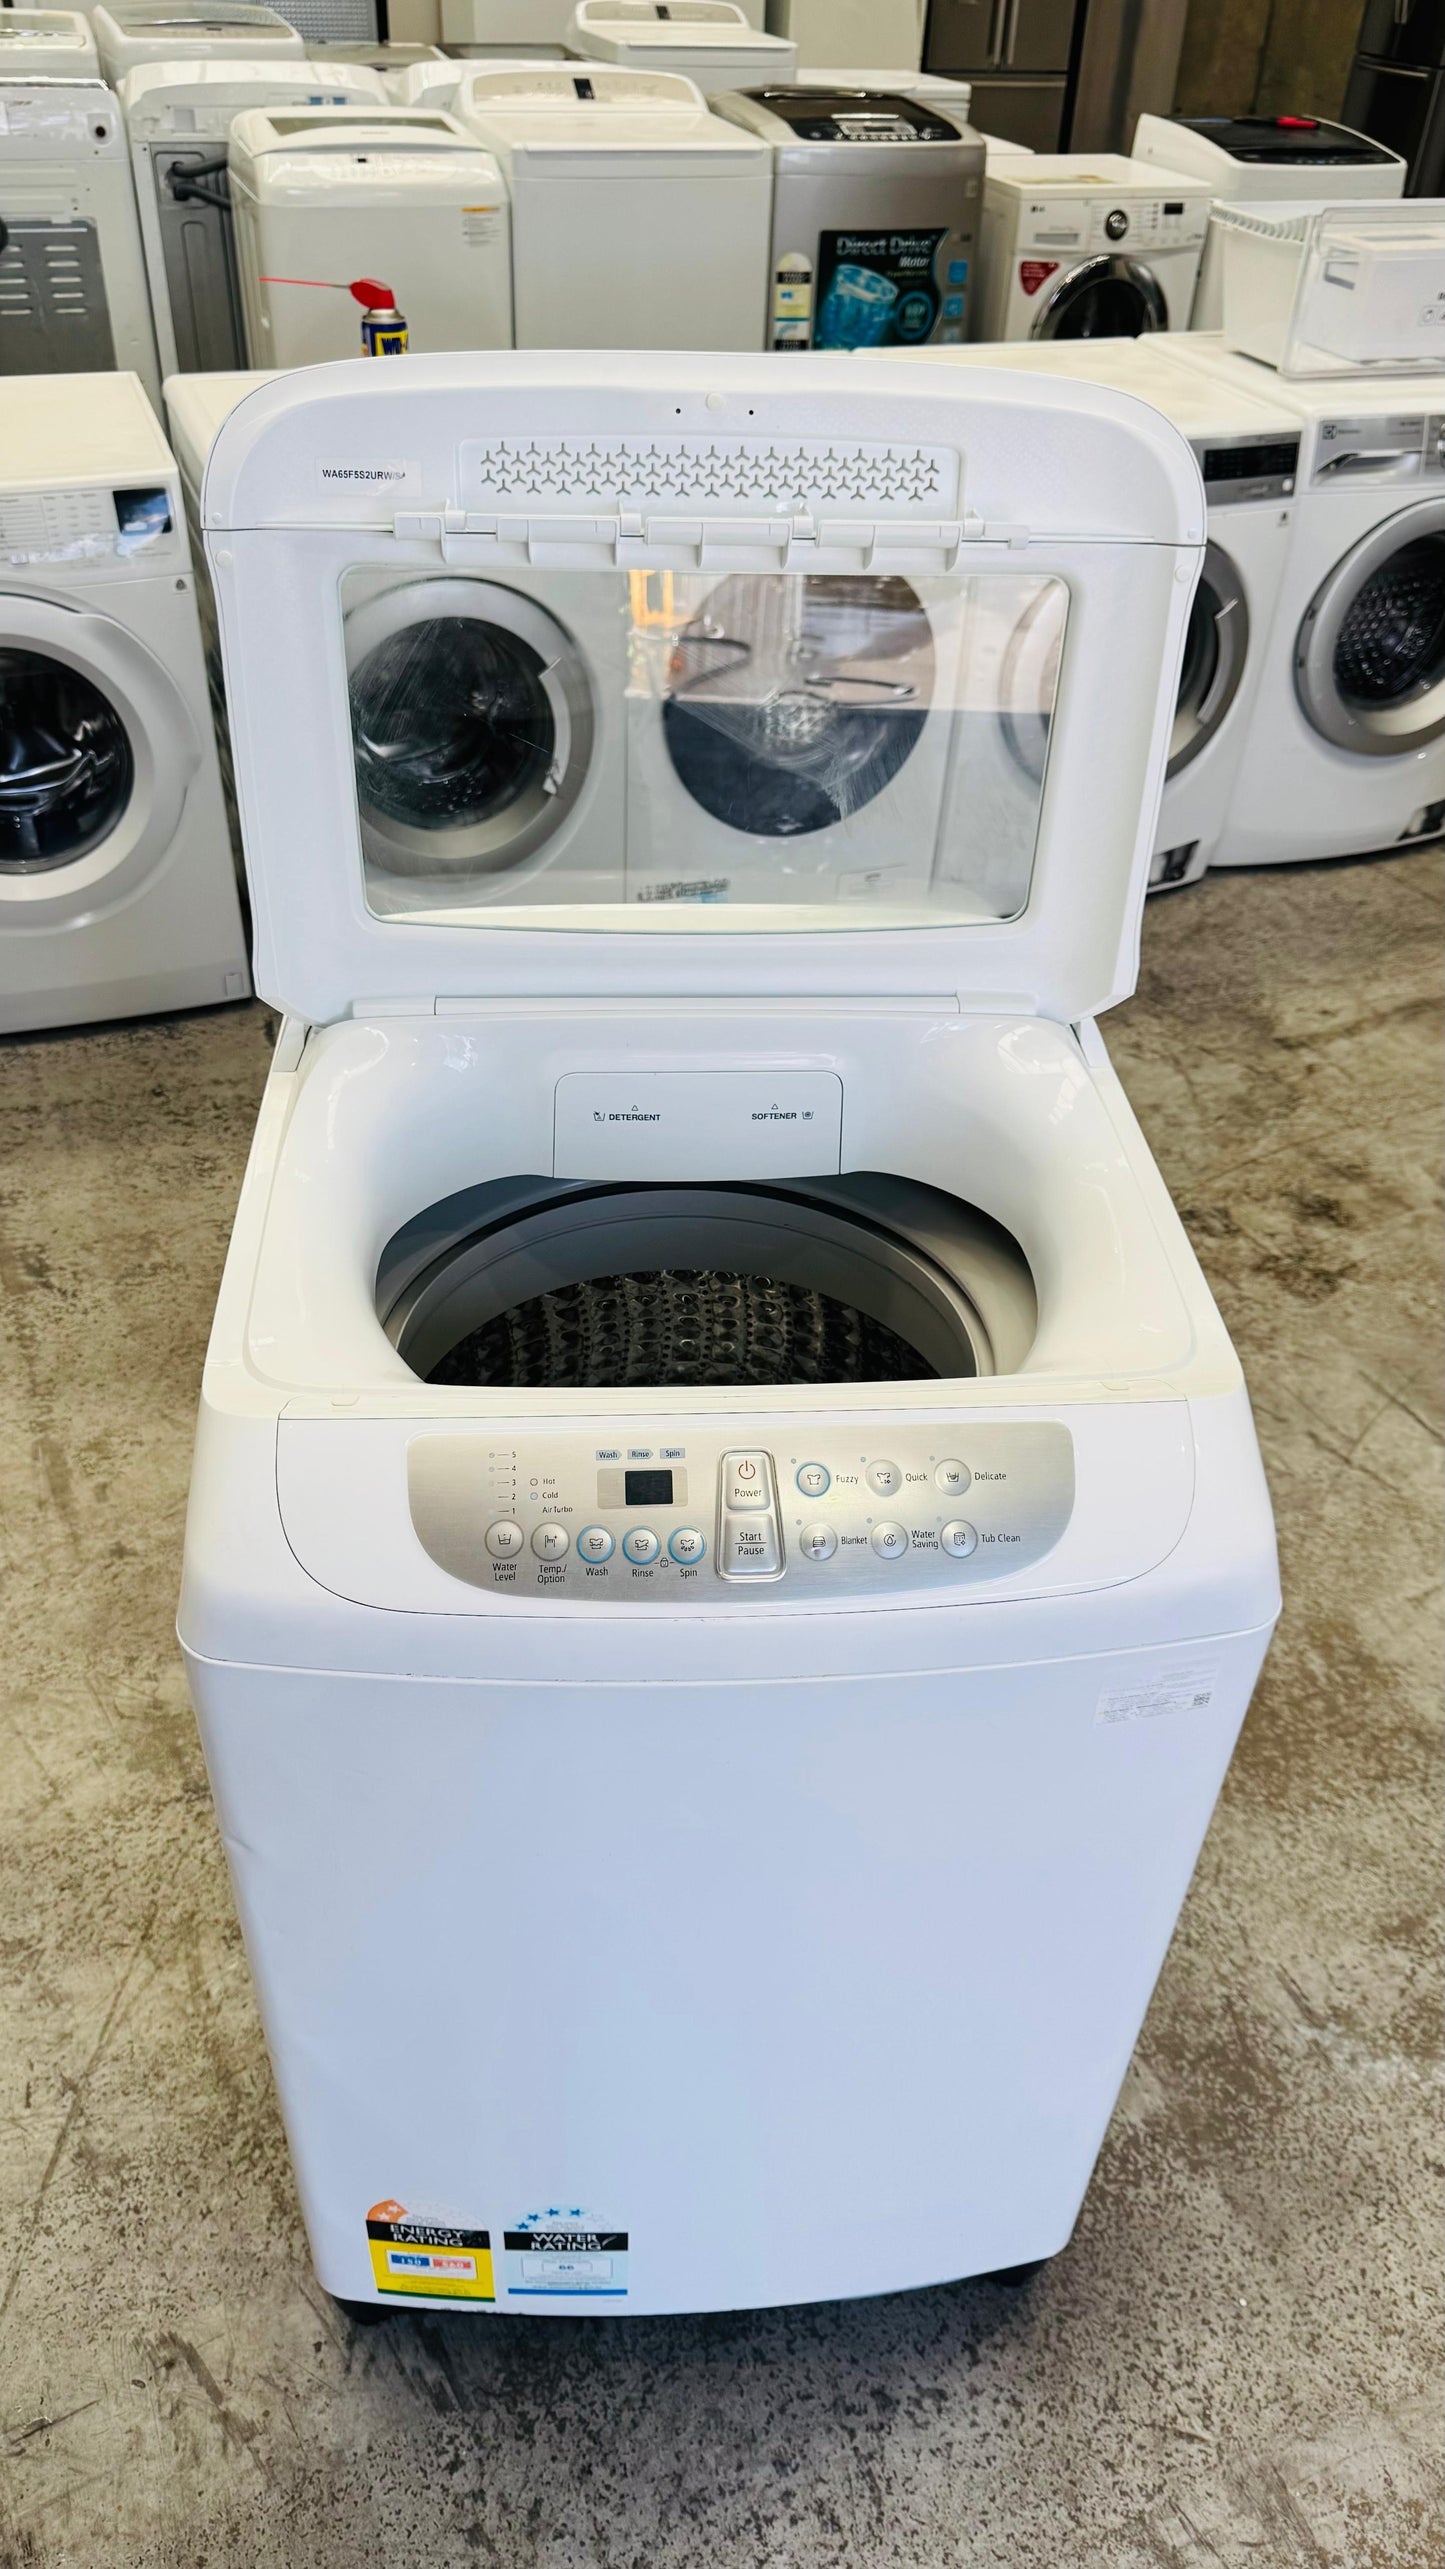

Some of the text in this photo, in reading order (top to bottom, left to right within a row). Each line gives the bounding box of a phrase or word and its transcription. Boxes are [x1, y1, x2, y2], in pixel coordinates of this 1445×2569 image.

[837, 236, 887, 255] Direct
[608, 1113, 661, 1121] DETERGENT
[751, 1111, 797, 1120] SOFTENER
[598, 1451, 618, 1459] Wash
[631, 1450, 650, 1458] Rinse
[665, 1449, 681, 1459] Spin
[835, 1474, 859, 1485] Fuzzy
[905, 1472, 928, 1481] Quick
[974, 1471, 1007, 1481] Delicate
[511, 1478, 517, 1486] 3
[542, 1491, 559, 1499] Cold
[734, 1488, 762, 1497] Power
[554, 1505, 573, 1513] Turbo
[740, 1531, 762, 1541] Start
[911, 1529, 936, 1539] Water
[981, 1533, 1021, 1543] Tub Clean
[841, 1535, 868, 1545] Blanket
[912, 1539, 939, 1549] Saving
[738, 1545, 765, 1555] Pause
[492, 1562, 518, 1572] Water
[538, 1564, 568, 1575] Temp./
[585, 1567, 609, 1577] Wash
[494, 1572, 516, 1581] Level
[632, 1568, 654, 1578] Rinse
[680, 1568, 698, 1579] Spin
[537, 1575, 565, 1585] Option
[390, 2224, 464, 2238] ENERGY
[393, 2233, 464, 2247] RATING
[533, 2233, 600, 2242] WATER
[531, 2241, 602, 2251] RATING
